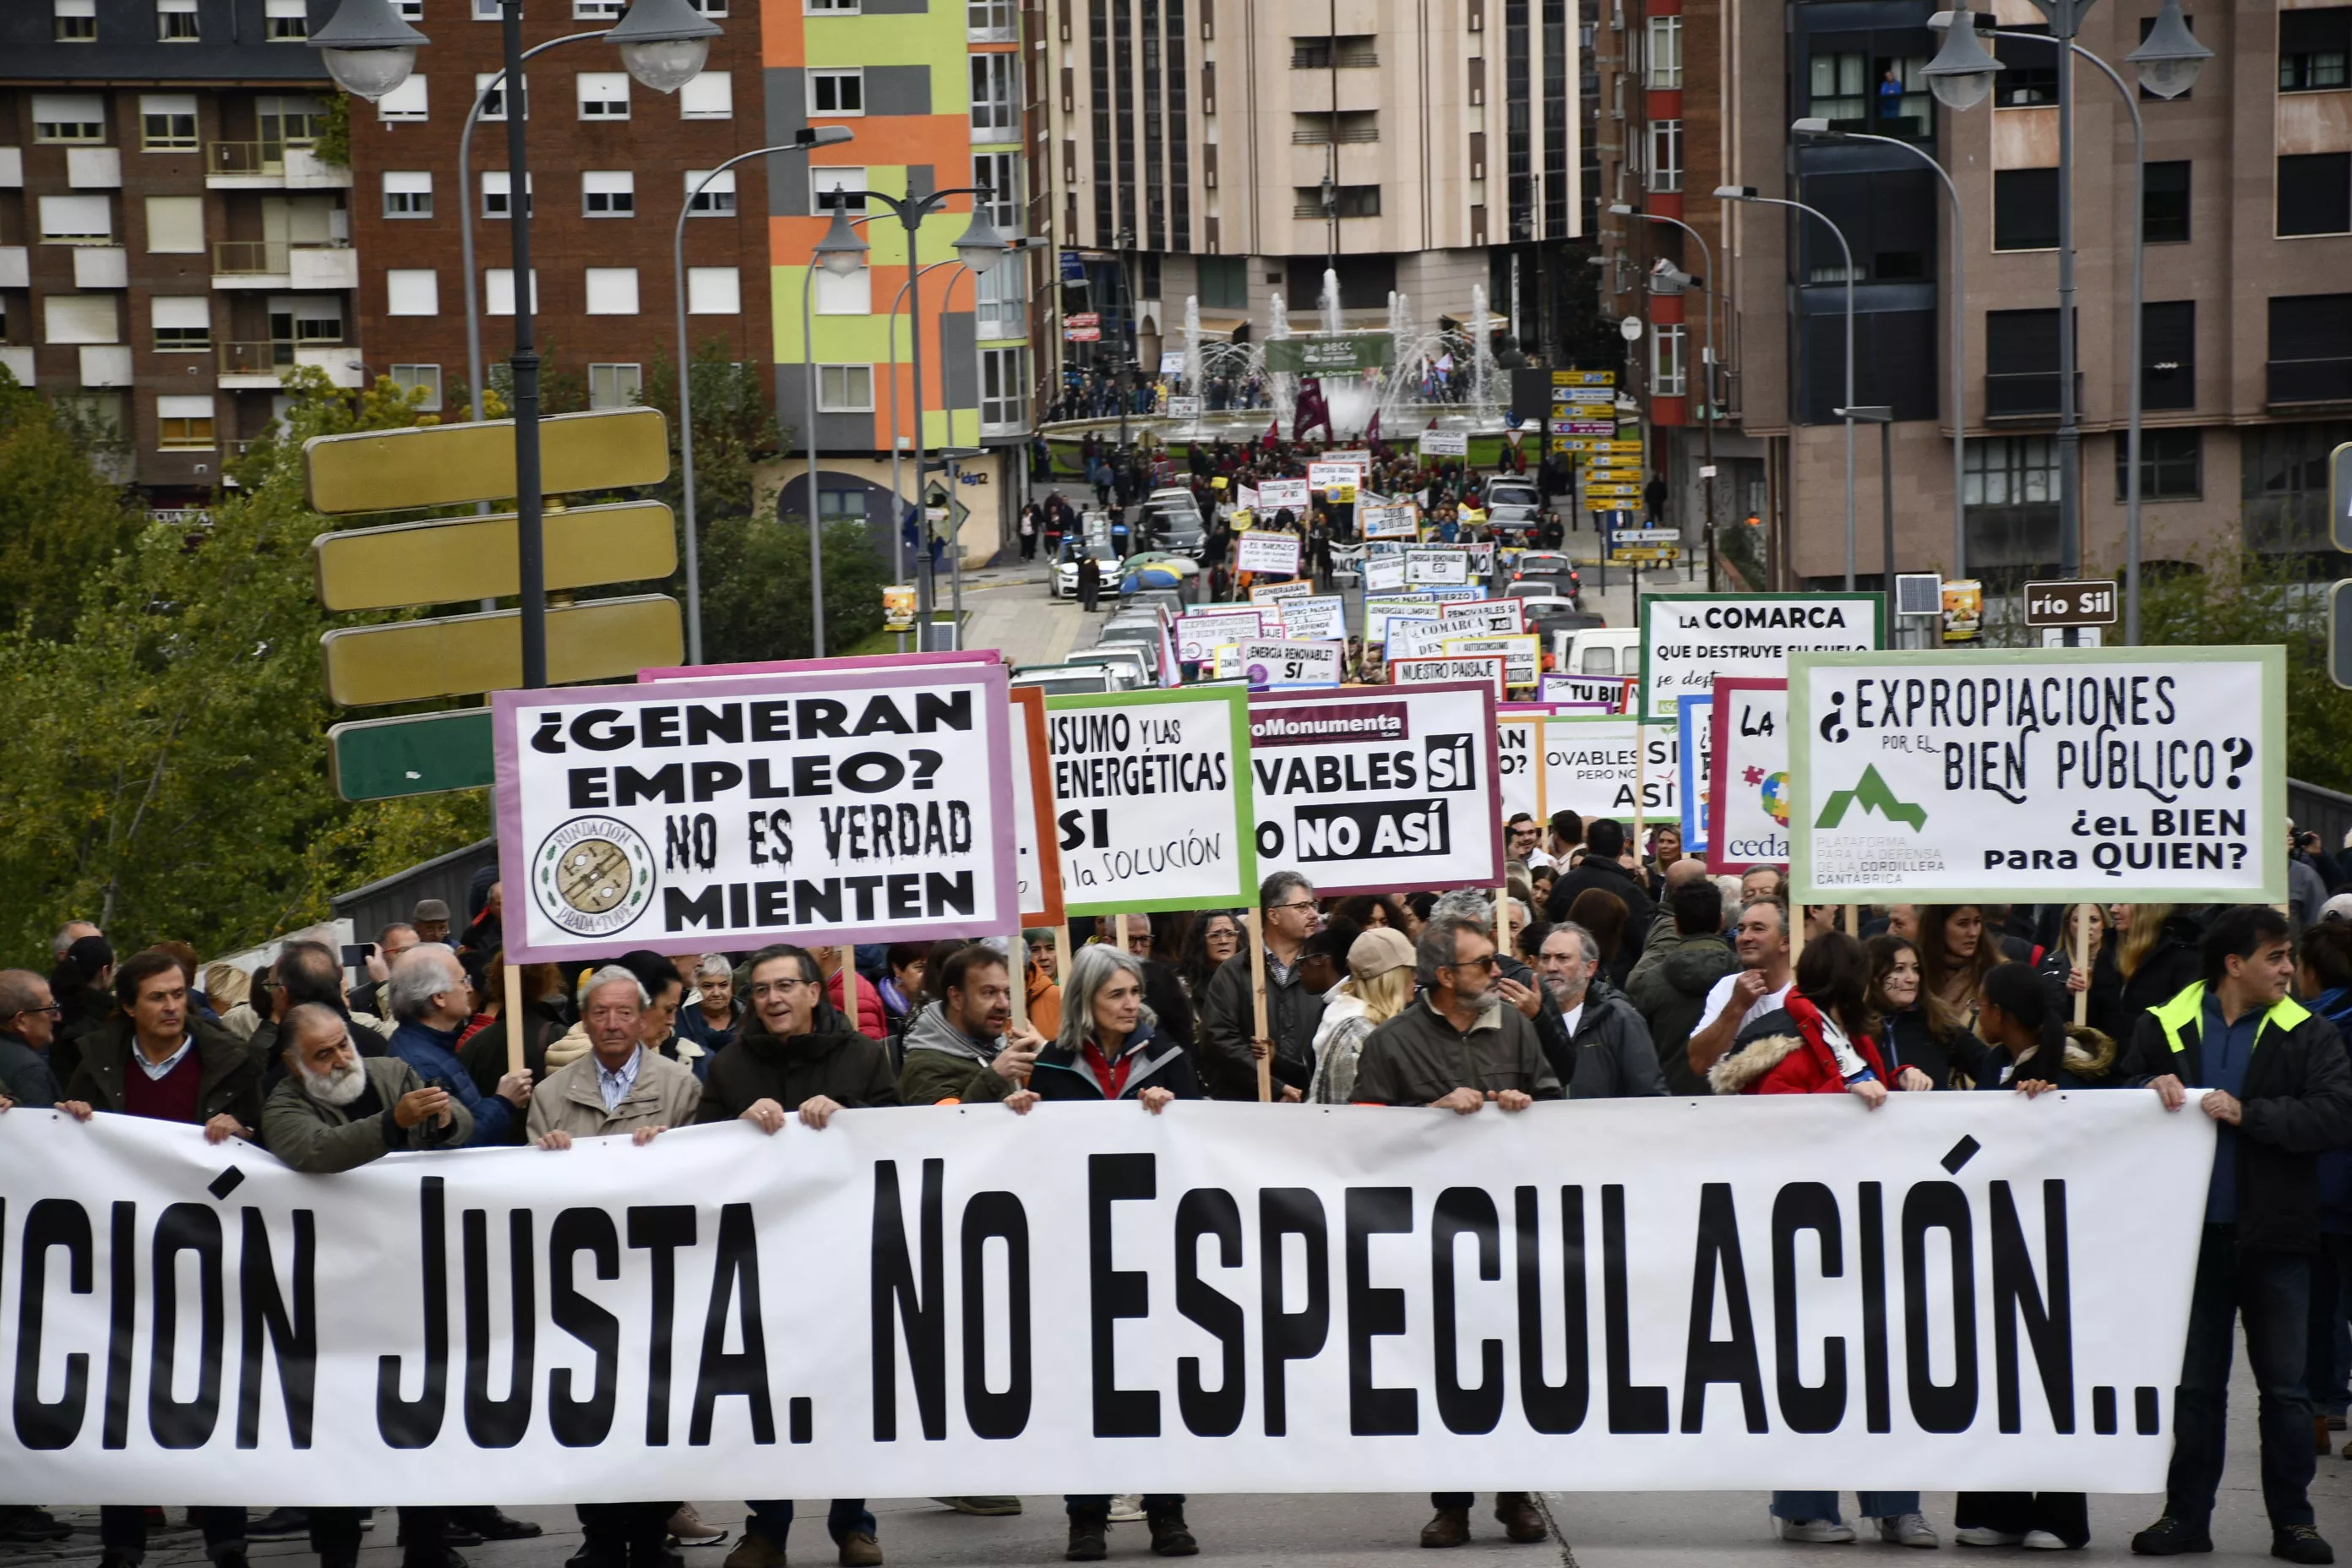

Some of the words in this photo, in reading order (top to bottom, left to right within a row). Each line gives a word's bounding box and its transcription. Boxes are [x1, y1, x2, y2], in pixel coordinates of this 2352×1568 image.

[2031, 593, 2069, 615] río
[2078, 591, 2111, 614] Sil
[1680, 616, 1700, 629] LA
[1705, 607, 1846, 629] COMARCA
[1657, 645, 1690, 661] QUE
[1696, 645, 1782, 658] DESTRUYE
[1402, 662, 1448, 681] NUESTRO
[1451, 660, 1494, 678] PAISAJE
[1571, 684, 1592, 700] TU
[531, 690, 973, 754] ¿GENERAN
[1740, 704, 1775, 738] LA
[1819, 676, 2176, 743] ¿EXPROPIACIONES
[1154, 719, 1181, 745] LAS
[1882, 734, 1913, 752] POR
[1916, 733, 1941, 754] EL
[1055, 747, 1227, 799] ENERGÉTICAS
[1250, 750, 1418, 796] VABLES
[1428, 736, 1471, 788] SÍ
[1576, 770, 1614, 780] PERO
[1945, 725, 2040, 804] BIEN
[568, 748, 944, 810] EMPLEO?
[553, 821, 633, 849] FUNDACIÓN
[1058, 808, 1109, 852] SI
[1297, 816, 1361, 858] NO
[1370, 800, 1444, 854] ASÍ
[2152, 808, 2246, 836] BIEN
[664, 812, 717, 874] NO
[748, 808, 792, 874] ES
[819, 799, 973, 867] VERDAD
[1817, 836, 1907, 847] PLATAFORMA
[1817, 848, 1852, 859] PARA
[1858, 849, 1875, 860] LA
[1879, 848, 1942, 860] DEFENSA
[1817, 862, 1835, 873] DE
[1839, 862, 1857, 873] LA
[1860, 861, 1946, 872] CORDILLERA
[2092, 841, 2248, 877] QUIEN?
[1816, 872, 1903, 885] CANTÁBRICA
[663, 870, 975, 932] MIENTEN
[0, 1164, 317, 1451] CIÓN
